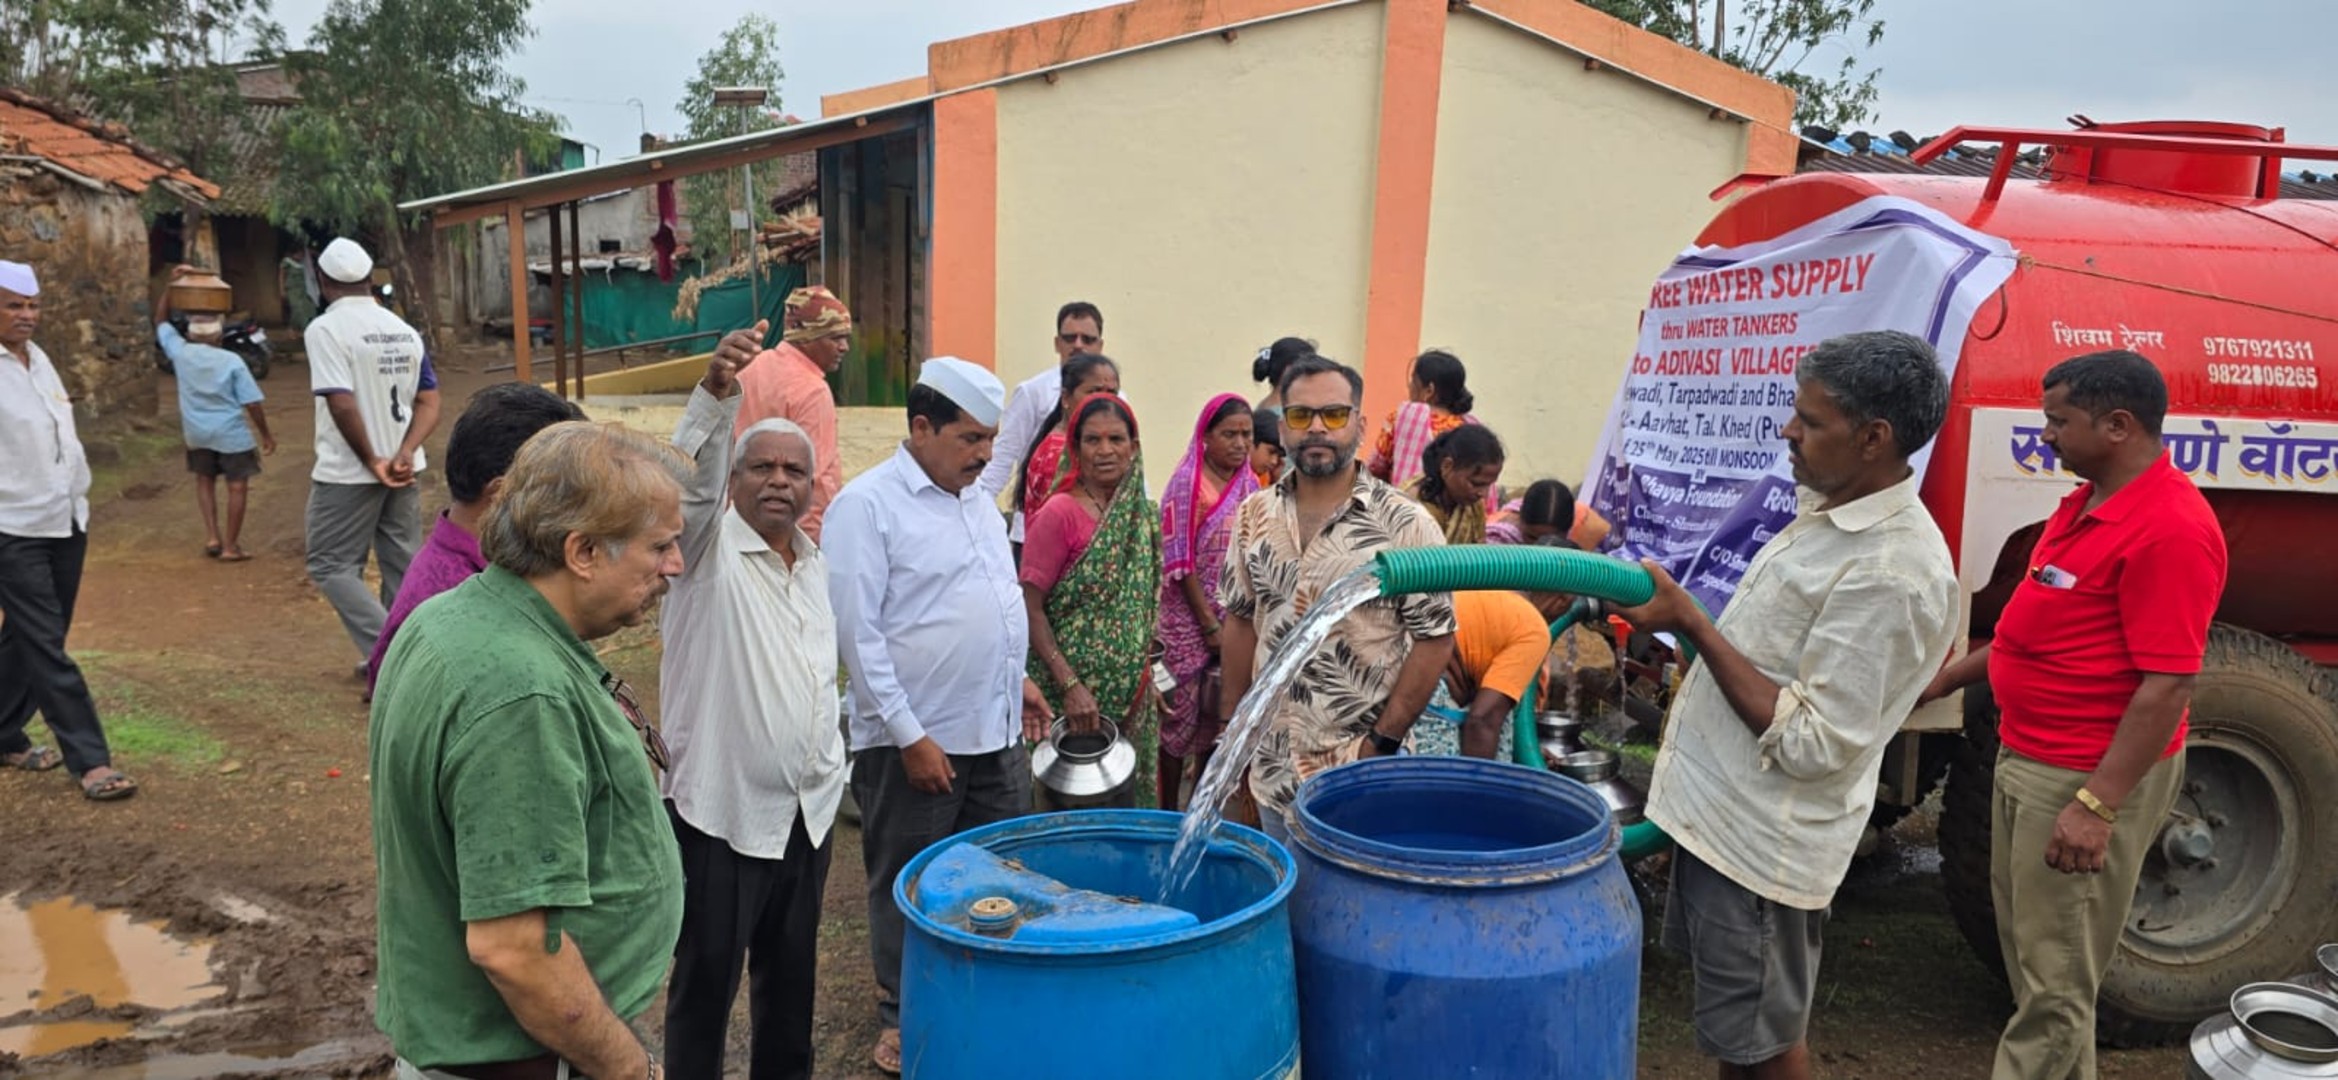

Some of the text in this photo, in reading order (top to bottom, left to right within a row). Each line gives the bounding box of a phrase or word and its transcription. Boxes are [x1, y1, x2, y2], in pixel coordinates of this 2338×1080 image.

[1686, 267, 1764, 306] WATER
[1770, 253, 1875, 299] SUPPLY
[1661, 312, 1798, 340] thru WATER TANKERS
[2052, 319, 2113, 347] शिवम
[1632, 344, 1818, 376] to ADIVASI VILLAG
[2203, 337, 2314, 361] 9767921311
[2208, 363, 2318, 389] 9822806265
[1669, 381, 1739, 412] Tarpadwadi
[1740, 382, 1765, 407] and
[1638, 410, 1689, 440] Aavhat,
[1695, 412, 1715, 437] Tal.
[1719, 413, 1753, 439] Khed
[1655, 443, 1679, 467] May
[1680, 445, 1705, 465] 2025
[1719, 449, 1778, 470] MONSOON
[2238, 420, 2338, 484] वॉट
